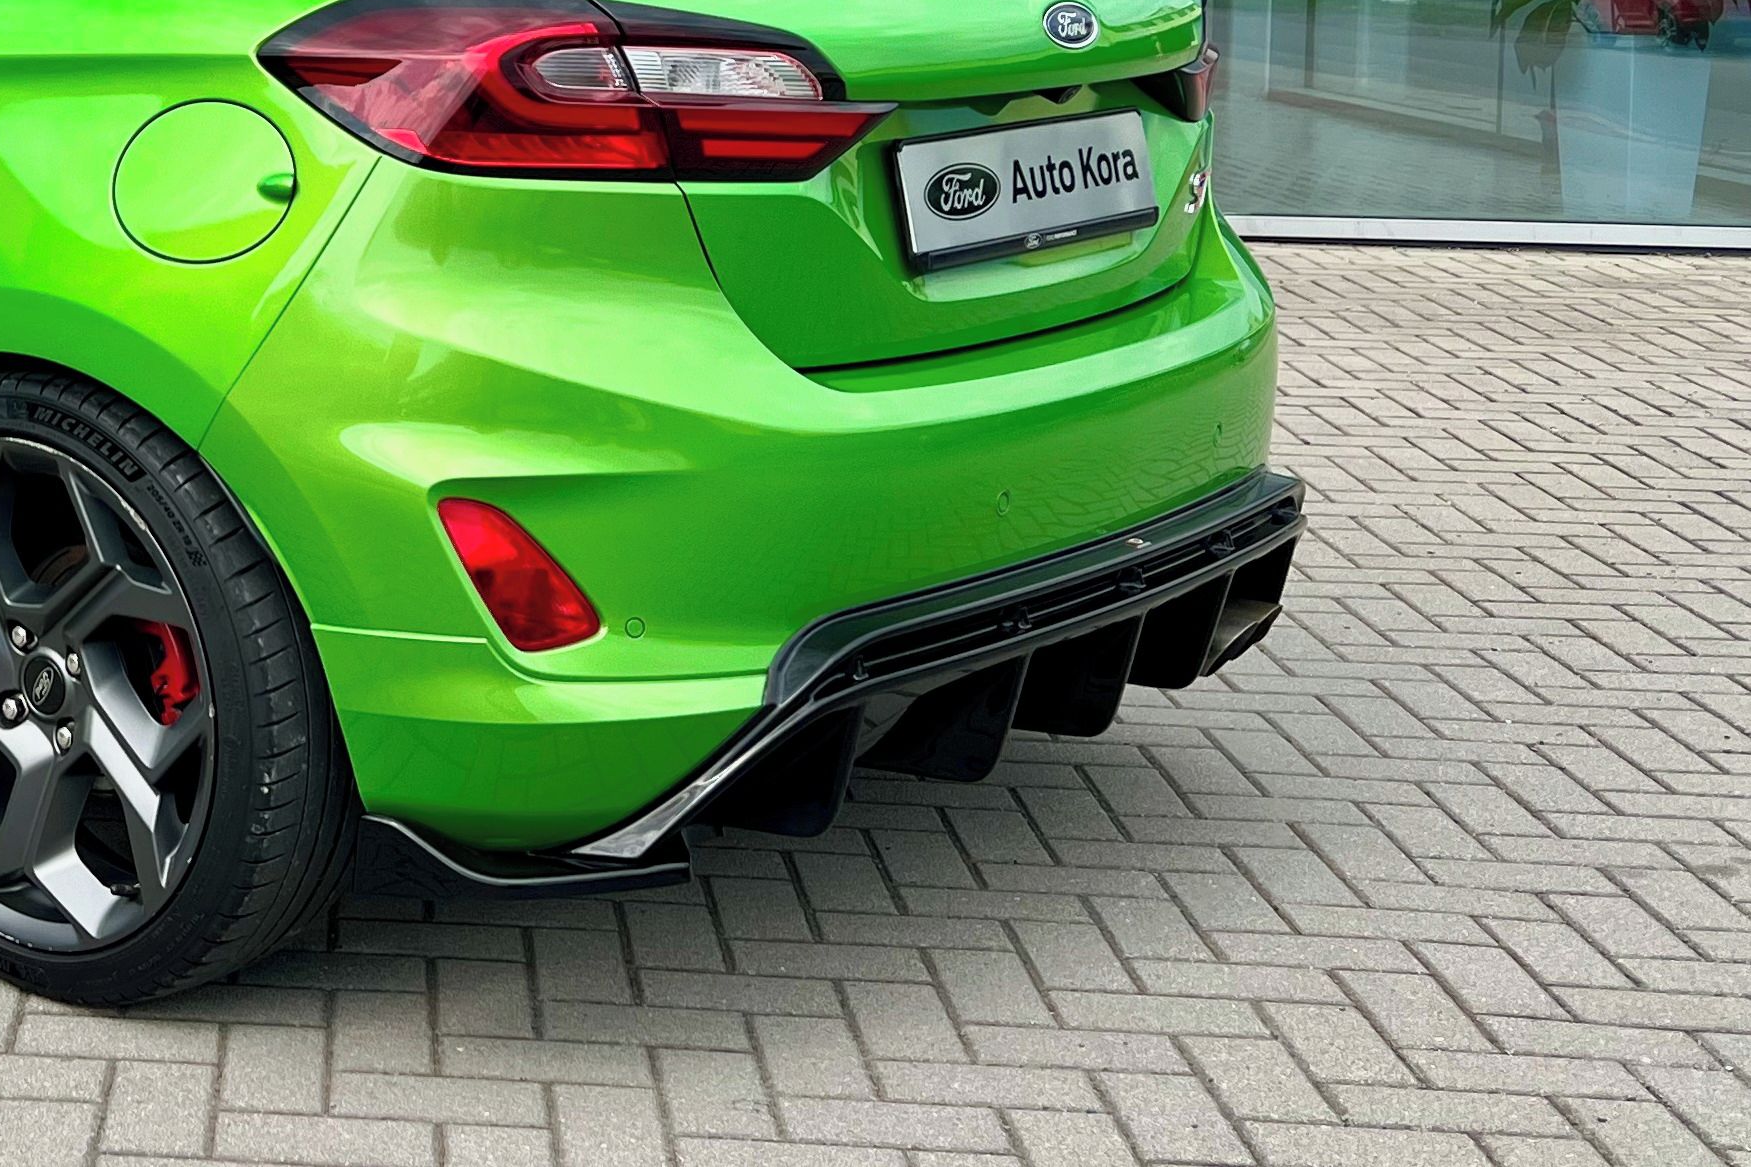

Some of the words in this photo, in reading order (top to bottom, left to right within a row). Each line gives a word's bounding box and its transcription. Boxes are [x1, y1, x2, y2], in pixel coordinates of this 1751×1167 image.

[1057, 10, 1087, 38] Ford
[940, 172, 986, 214] Ford
[1011, 159, 1074, 204] Auto
[1078, 144, 1139, 189] Kora
[33, 407, 138, 476] MICHELIN
